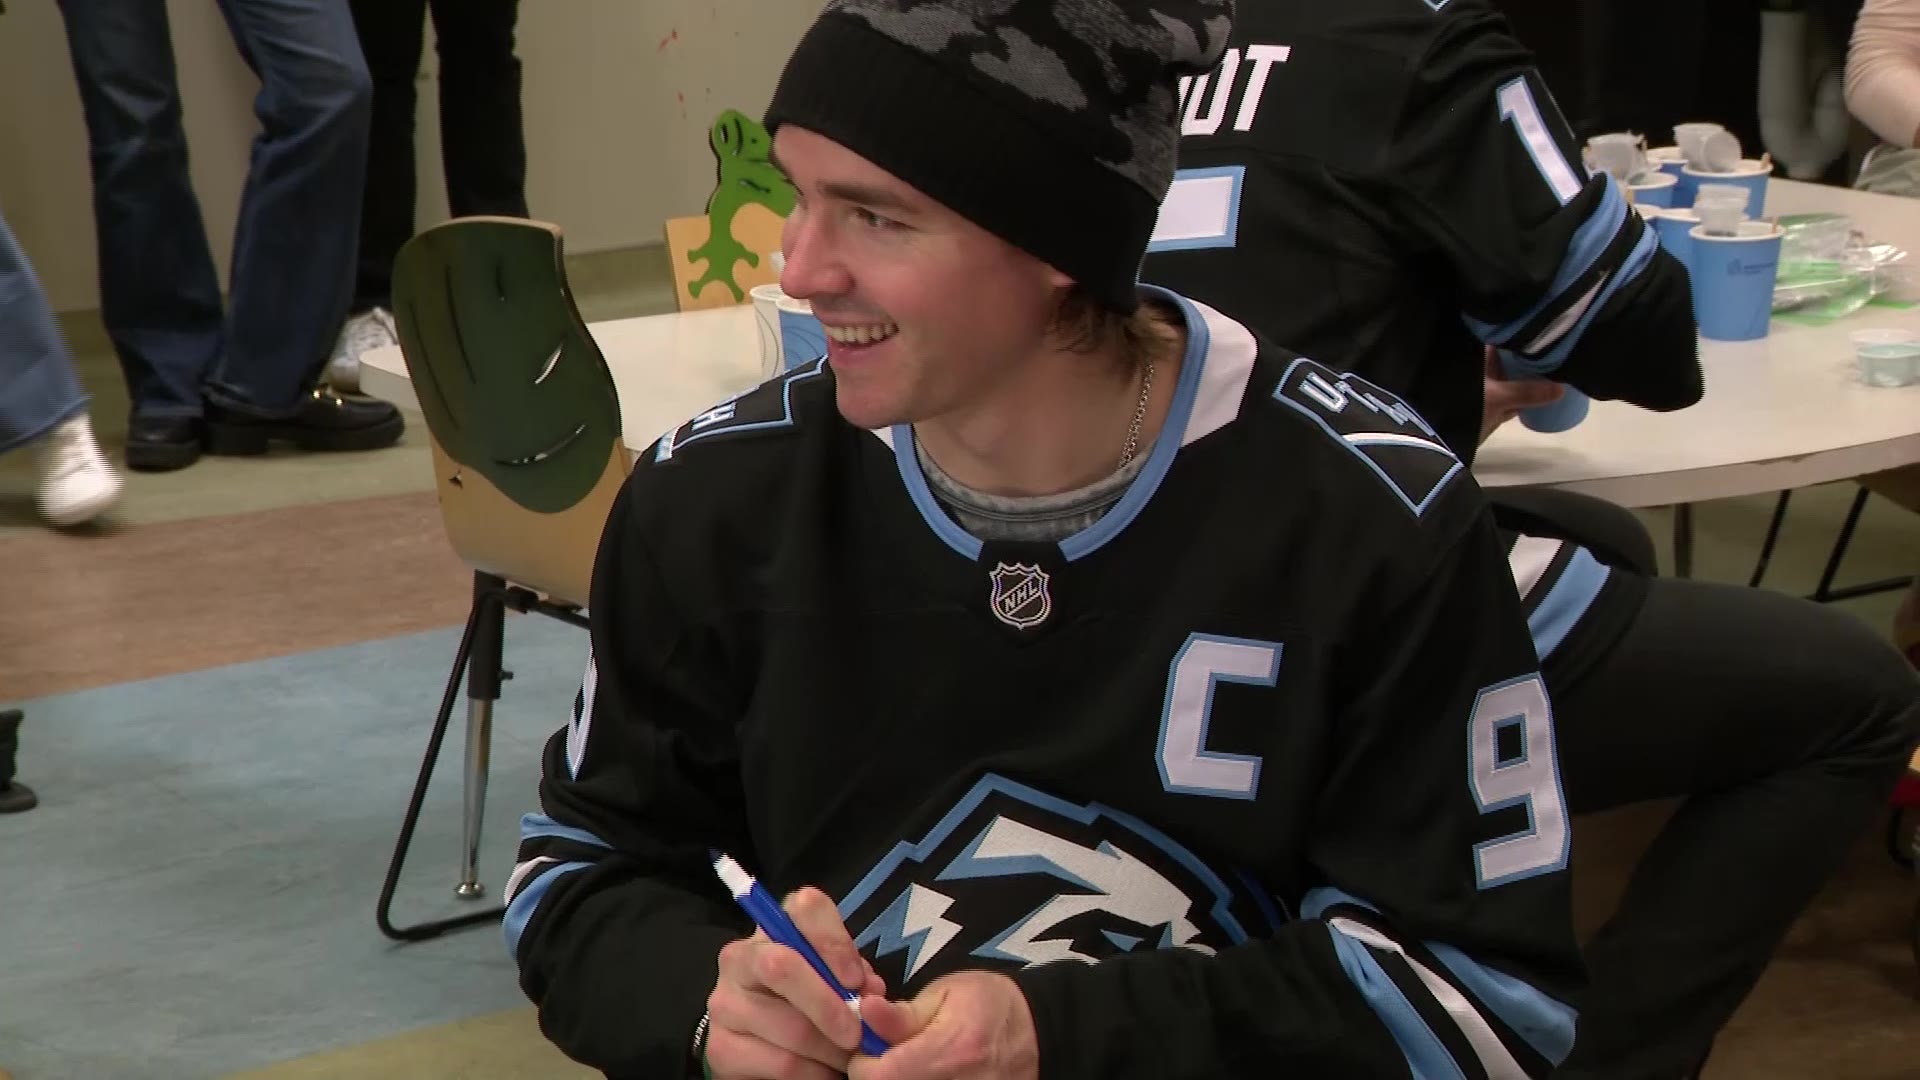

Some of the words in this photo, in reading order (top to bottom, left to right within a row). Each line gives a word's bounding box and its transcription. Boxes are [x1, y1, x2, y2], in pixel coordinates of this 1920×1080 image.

[1178, 44, 1291, 136] OT
[1004, 581, 1038, 613] NHL
[1155, 632, 1284, 801] C
[1467, 672, 1571, 890] 9
